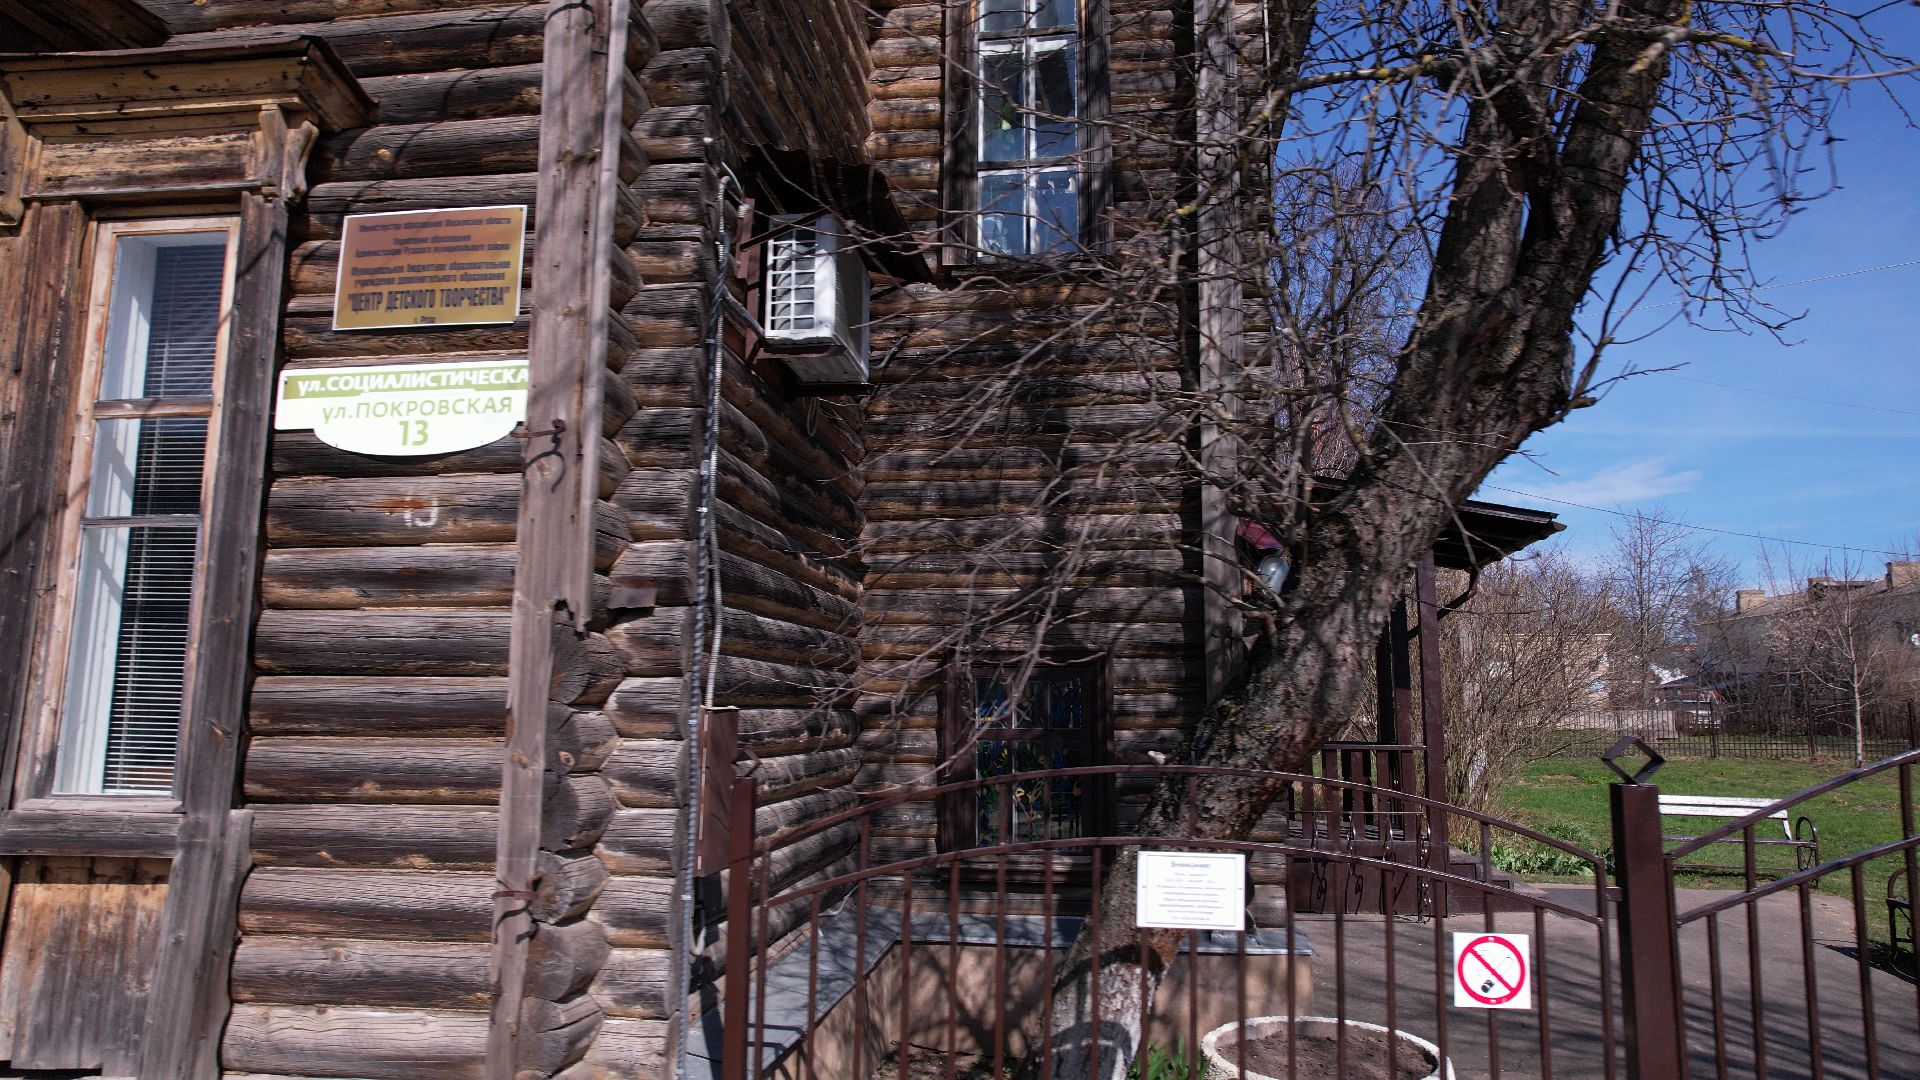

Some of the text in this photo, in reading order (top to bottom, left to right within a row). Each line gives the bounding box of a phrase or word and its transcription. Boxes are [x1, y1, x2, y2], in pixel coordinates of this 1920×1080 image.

[348, 286, 510, 314] "ЦЕНТР ДЕТСКОГО ТВОРЧЕСТВА"
[322, 396, 513, 424] ул.ПОКРОВСКАЯ
[399, 419, 429, 446] 13
